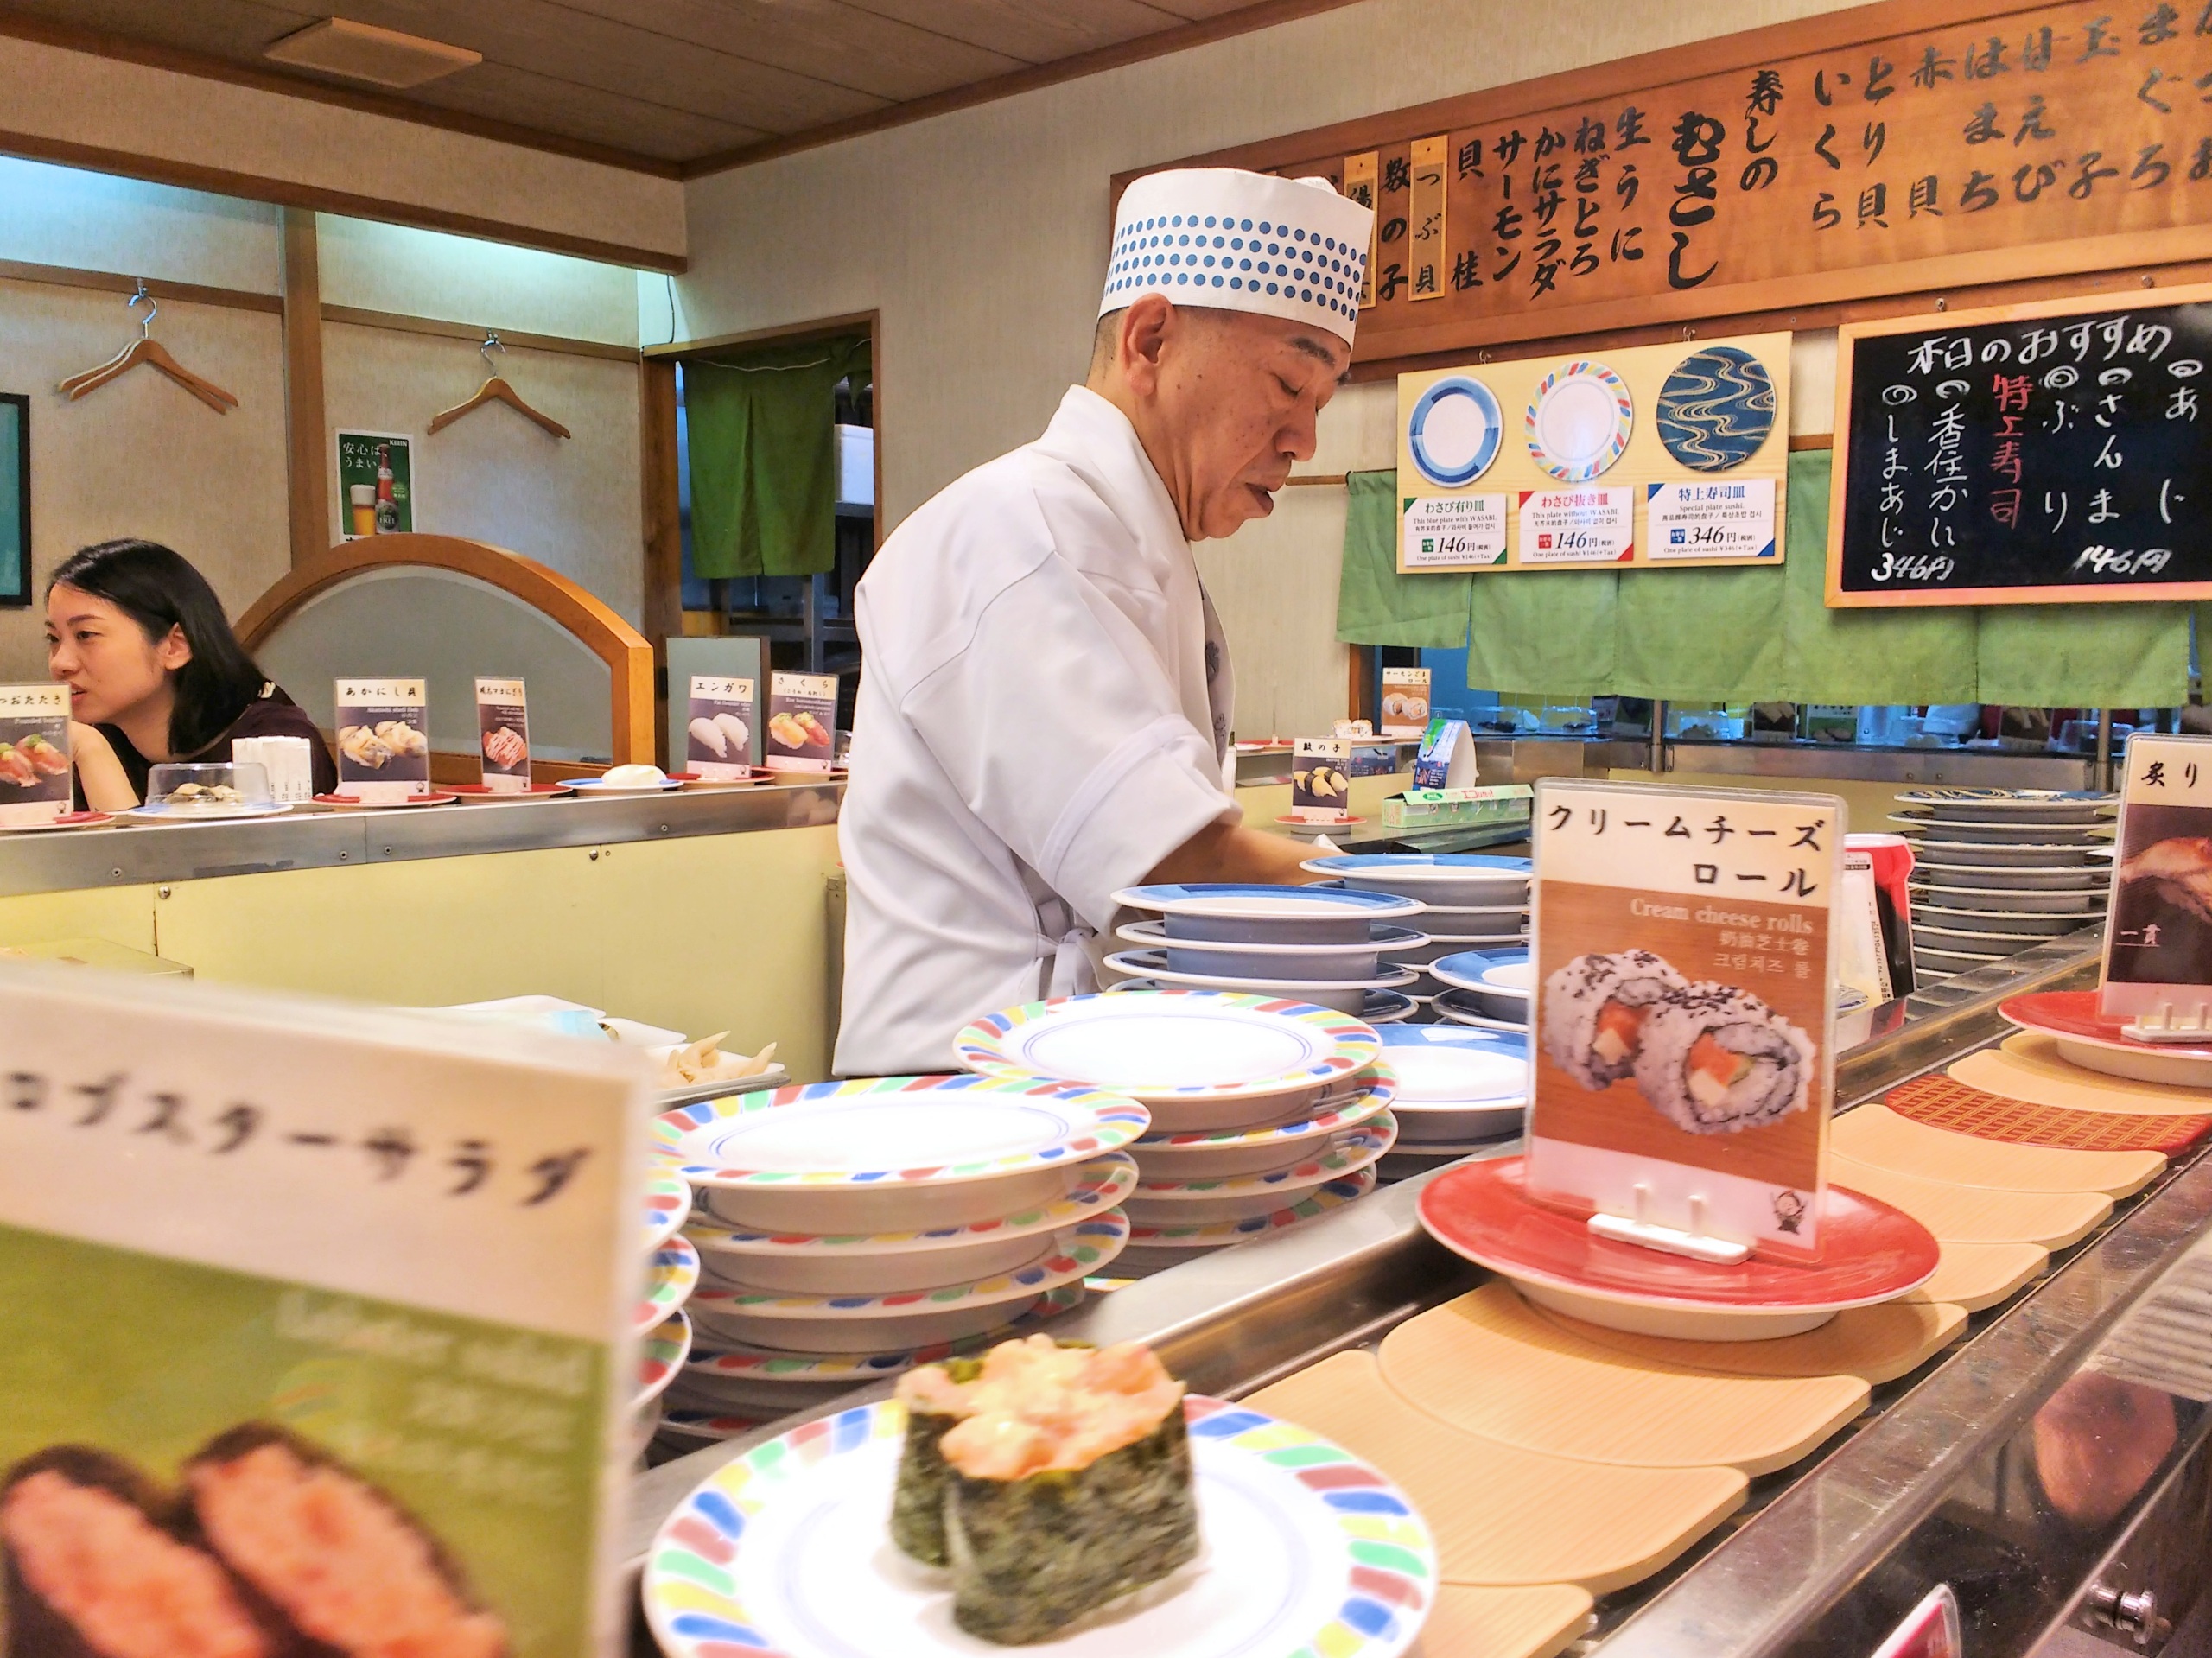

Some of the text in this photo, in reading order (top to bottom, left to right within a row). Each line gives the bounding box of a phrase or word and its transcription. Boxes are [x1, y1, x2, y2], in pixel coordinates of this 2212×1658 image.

[1608, 105, 1652, 262] 生うに
[1812, 69, 1851, 231] いくら
[1855, 55, 1896, 230] とり貝
[1908, 46, 1954, 219] 赤貝
[1960, 36, 2010, 212] はまち
[1379, 157, 1411, 302] 数の子
[1414, 173, 1442, 293] つぶ貝
[1491, 130, 1529, 282] サーモン
[1529, 126, 1569, 301] かにサラダ
[1569, 116, 1611, 276] ねぎとろ
[1668, 111, 1726, 290] むさし
[1425, 499, 1485, 514] わさび有り皿
[1541, 492, 1608, 508] わさび抜き皿
[1547, 511, 1561, 520] plate
[1678, 485, 1745, 502] 特上寿司皿
[1879, 414, 1909, 547] しまあじ
[2042, 400, 2079, 534] ぶり
[2088, 392, 2124, 524] さんま
[2158, 386, 2200, 524] あじ
[1440, 517, 1453, 525] plate
[1677, 546, 1694, 555] plate
[346, 687, 416, 696] あかにし貝
[696, 682, 747, 694] エンガワ
[778, 677, 829, 689] さくら
[1548, 804, 1827, 852] クリームチーズ
[2140, 761, 2198, 787] 炙り
[1630, 898, 1814, 935] Cream cheese rolls
[1694, 862, 1818, 898] ロール
